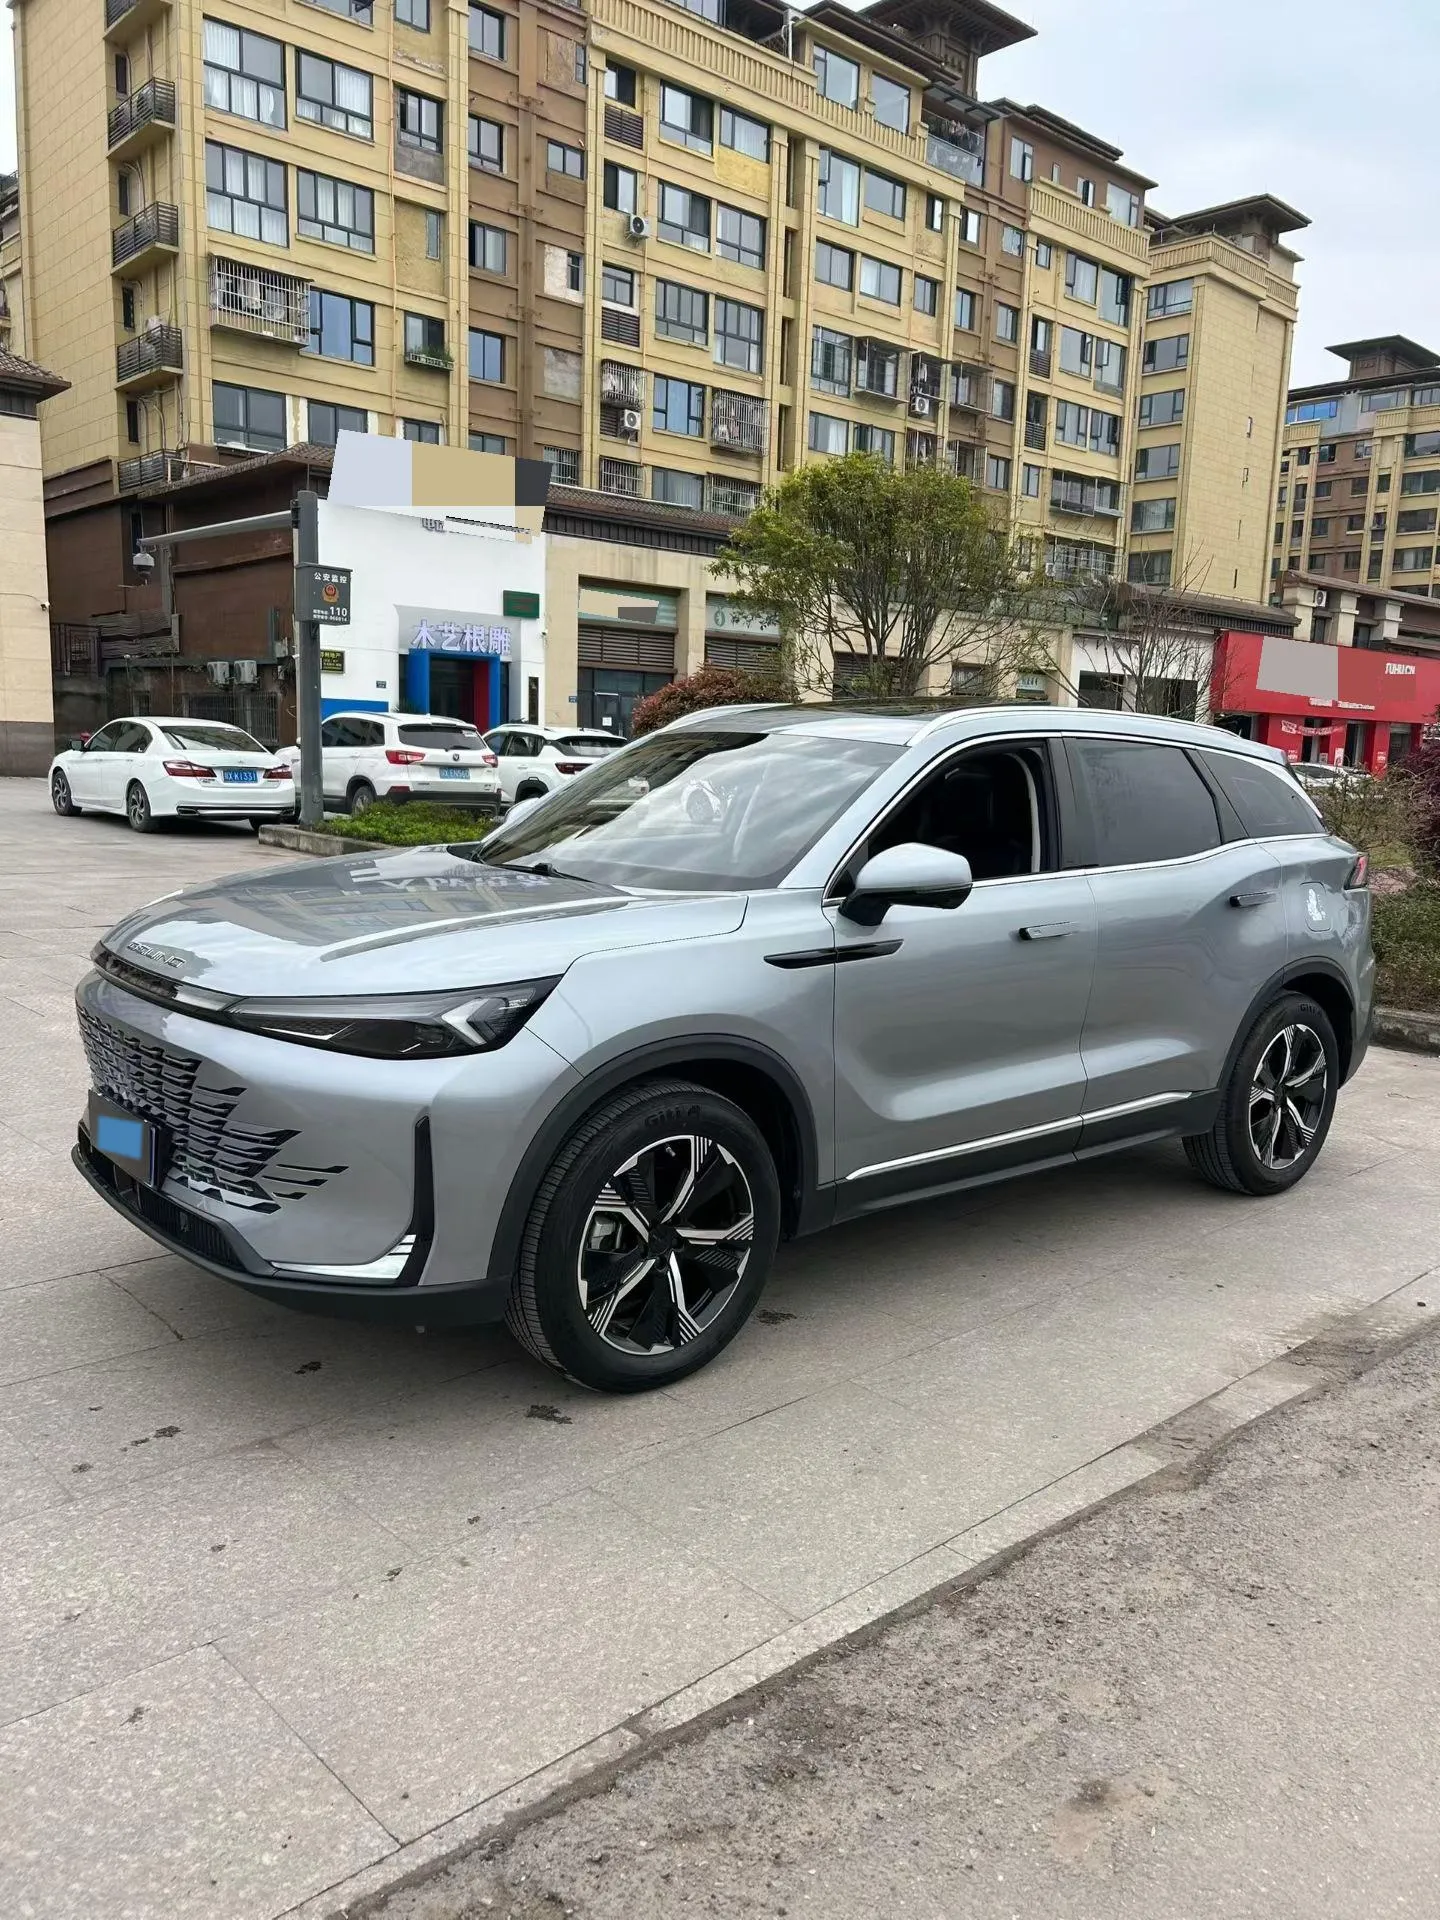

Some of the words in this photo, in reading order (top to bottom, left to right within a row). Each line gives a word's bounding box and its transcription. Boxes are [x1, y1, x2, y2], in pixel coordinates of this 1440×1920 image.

[314, 572, 348, 584] 公安监控
[330, 606, 348, 617] 110
[411, 618, 512, 655] 木艺根雕
